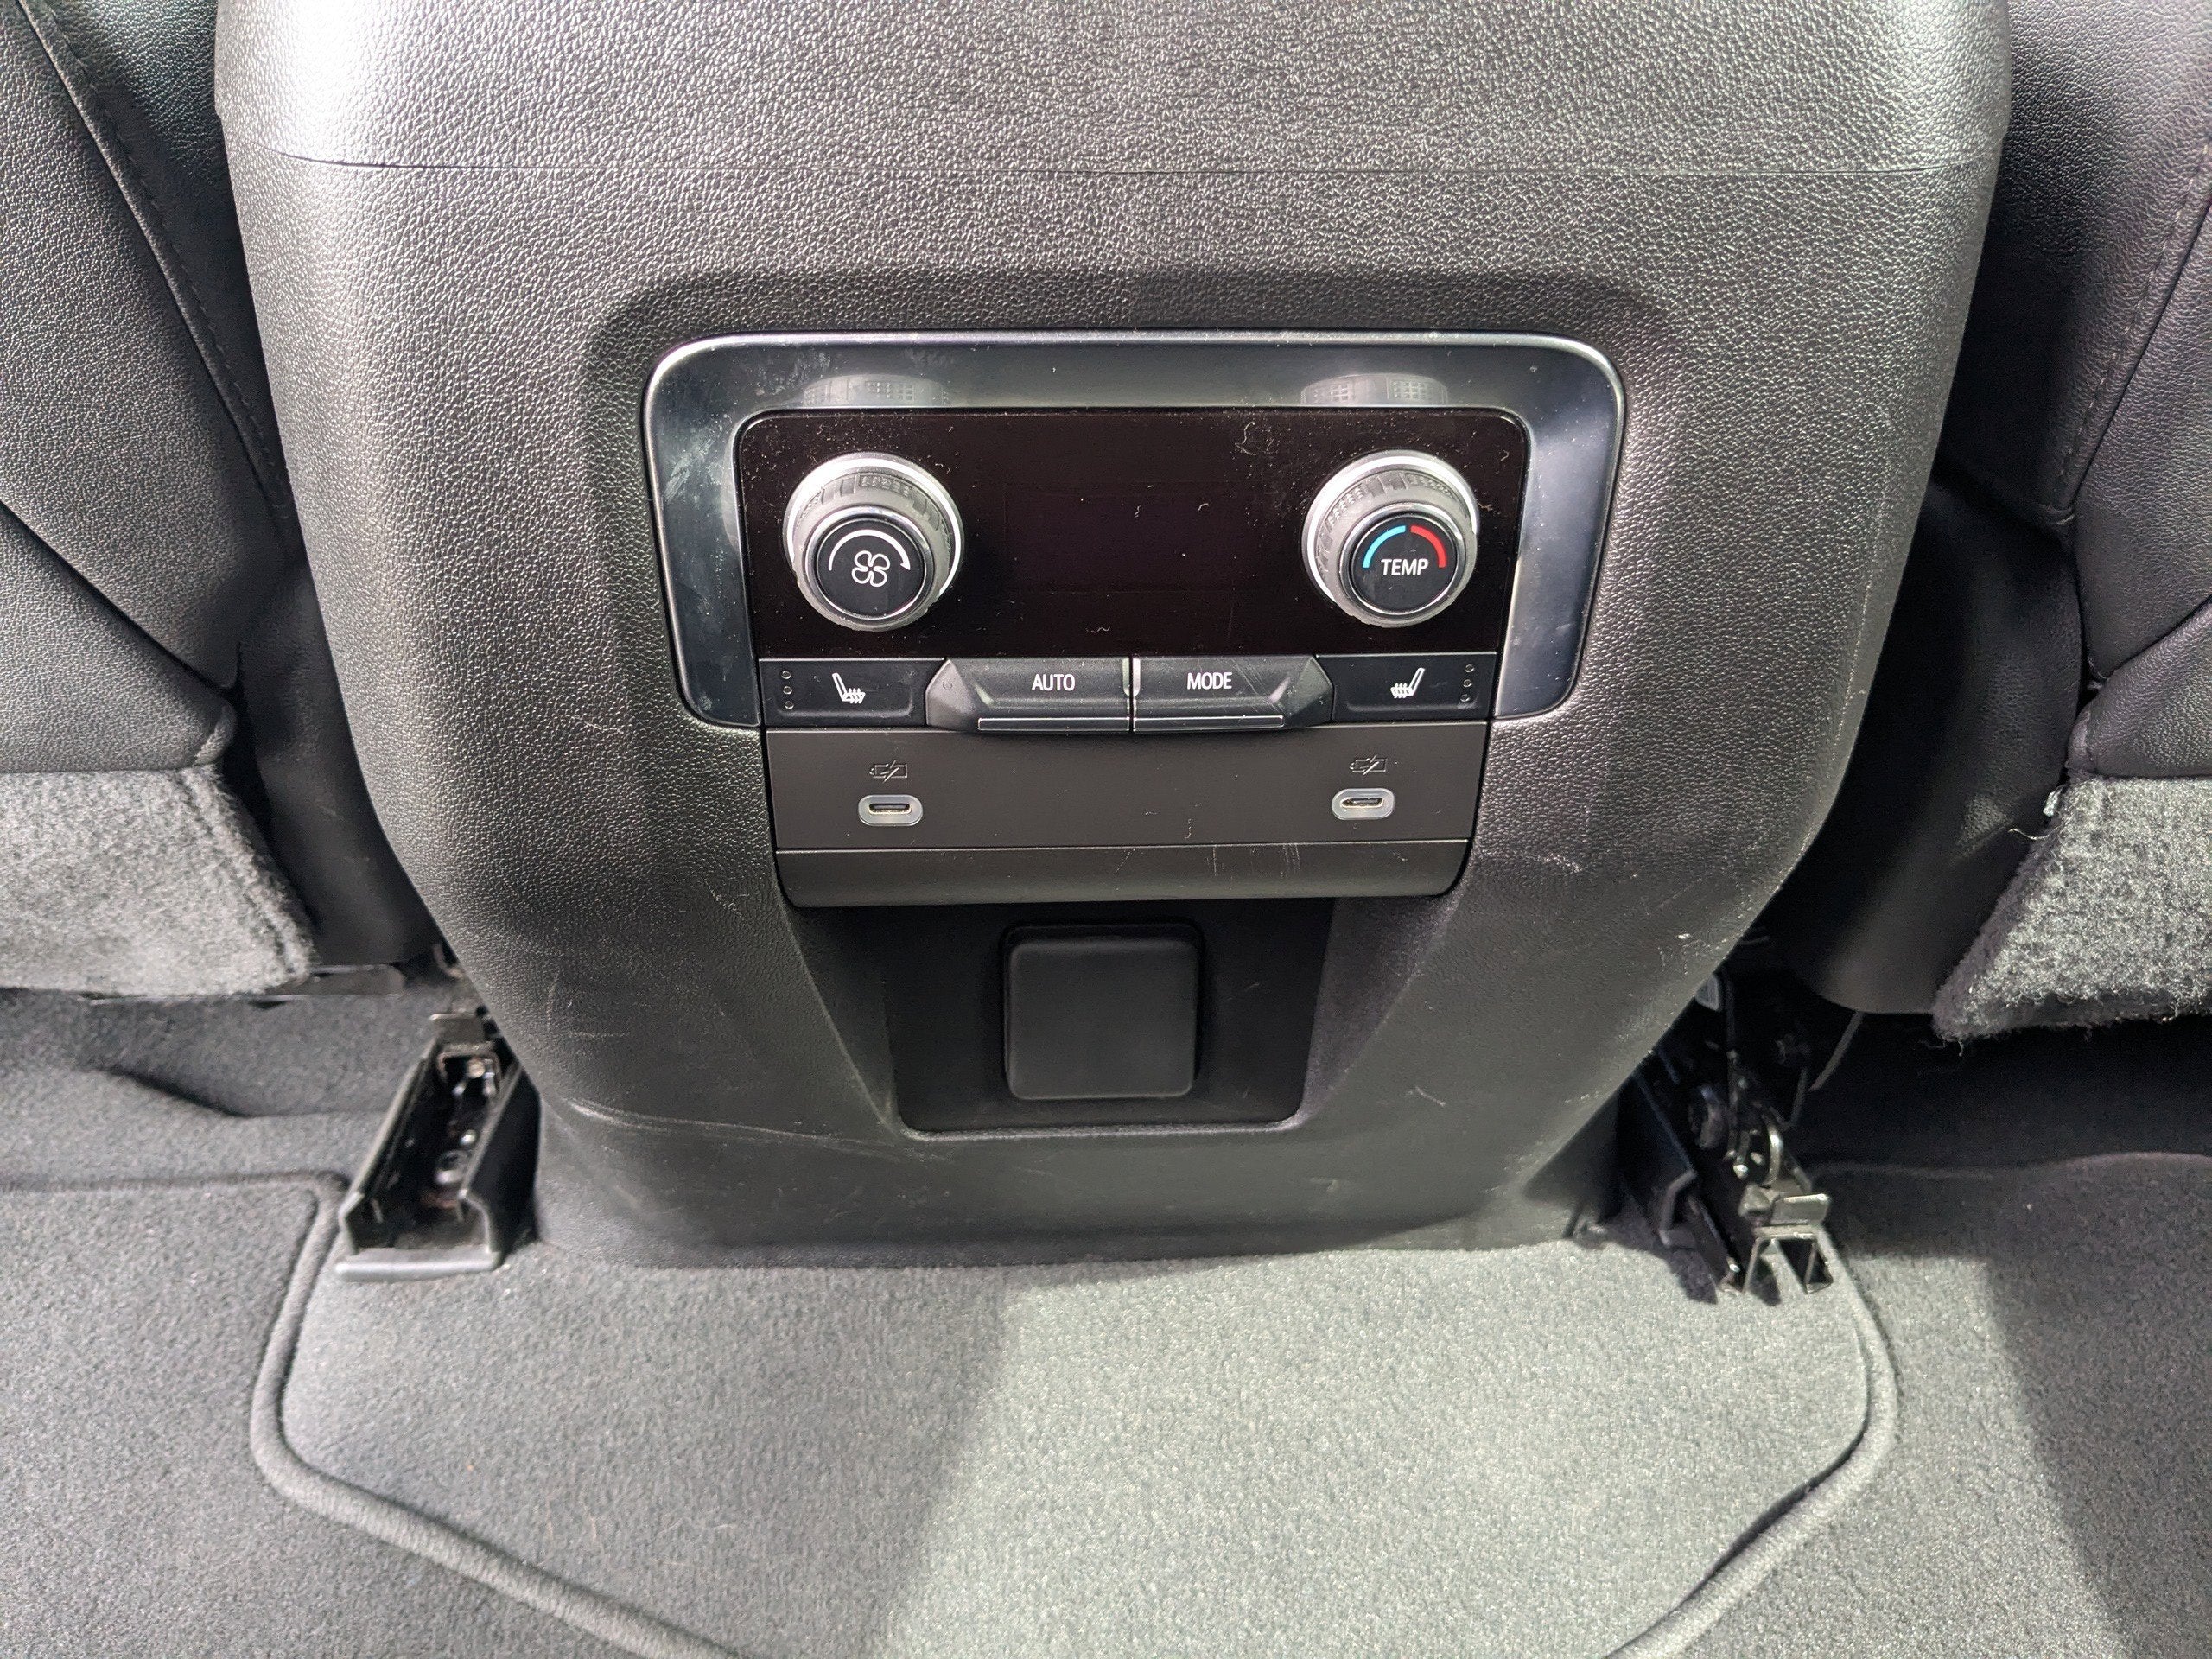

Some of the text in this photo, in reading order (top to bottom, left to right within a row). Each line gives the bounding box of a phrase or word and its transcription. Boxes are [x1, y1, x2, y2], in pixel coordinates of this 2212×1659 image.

[1380, 558, 1429, 576] TEMP
[1031, 673, 1076, 691] AUTO
[1186, 671, 1233, 690] MODE
